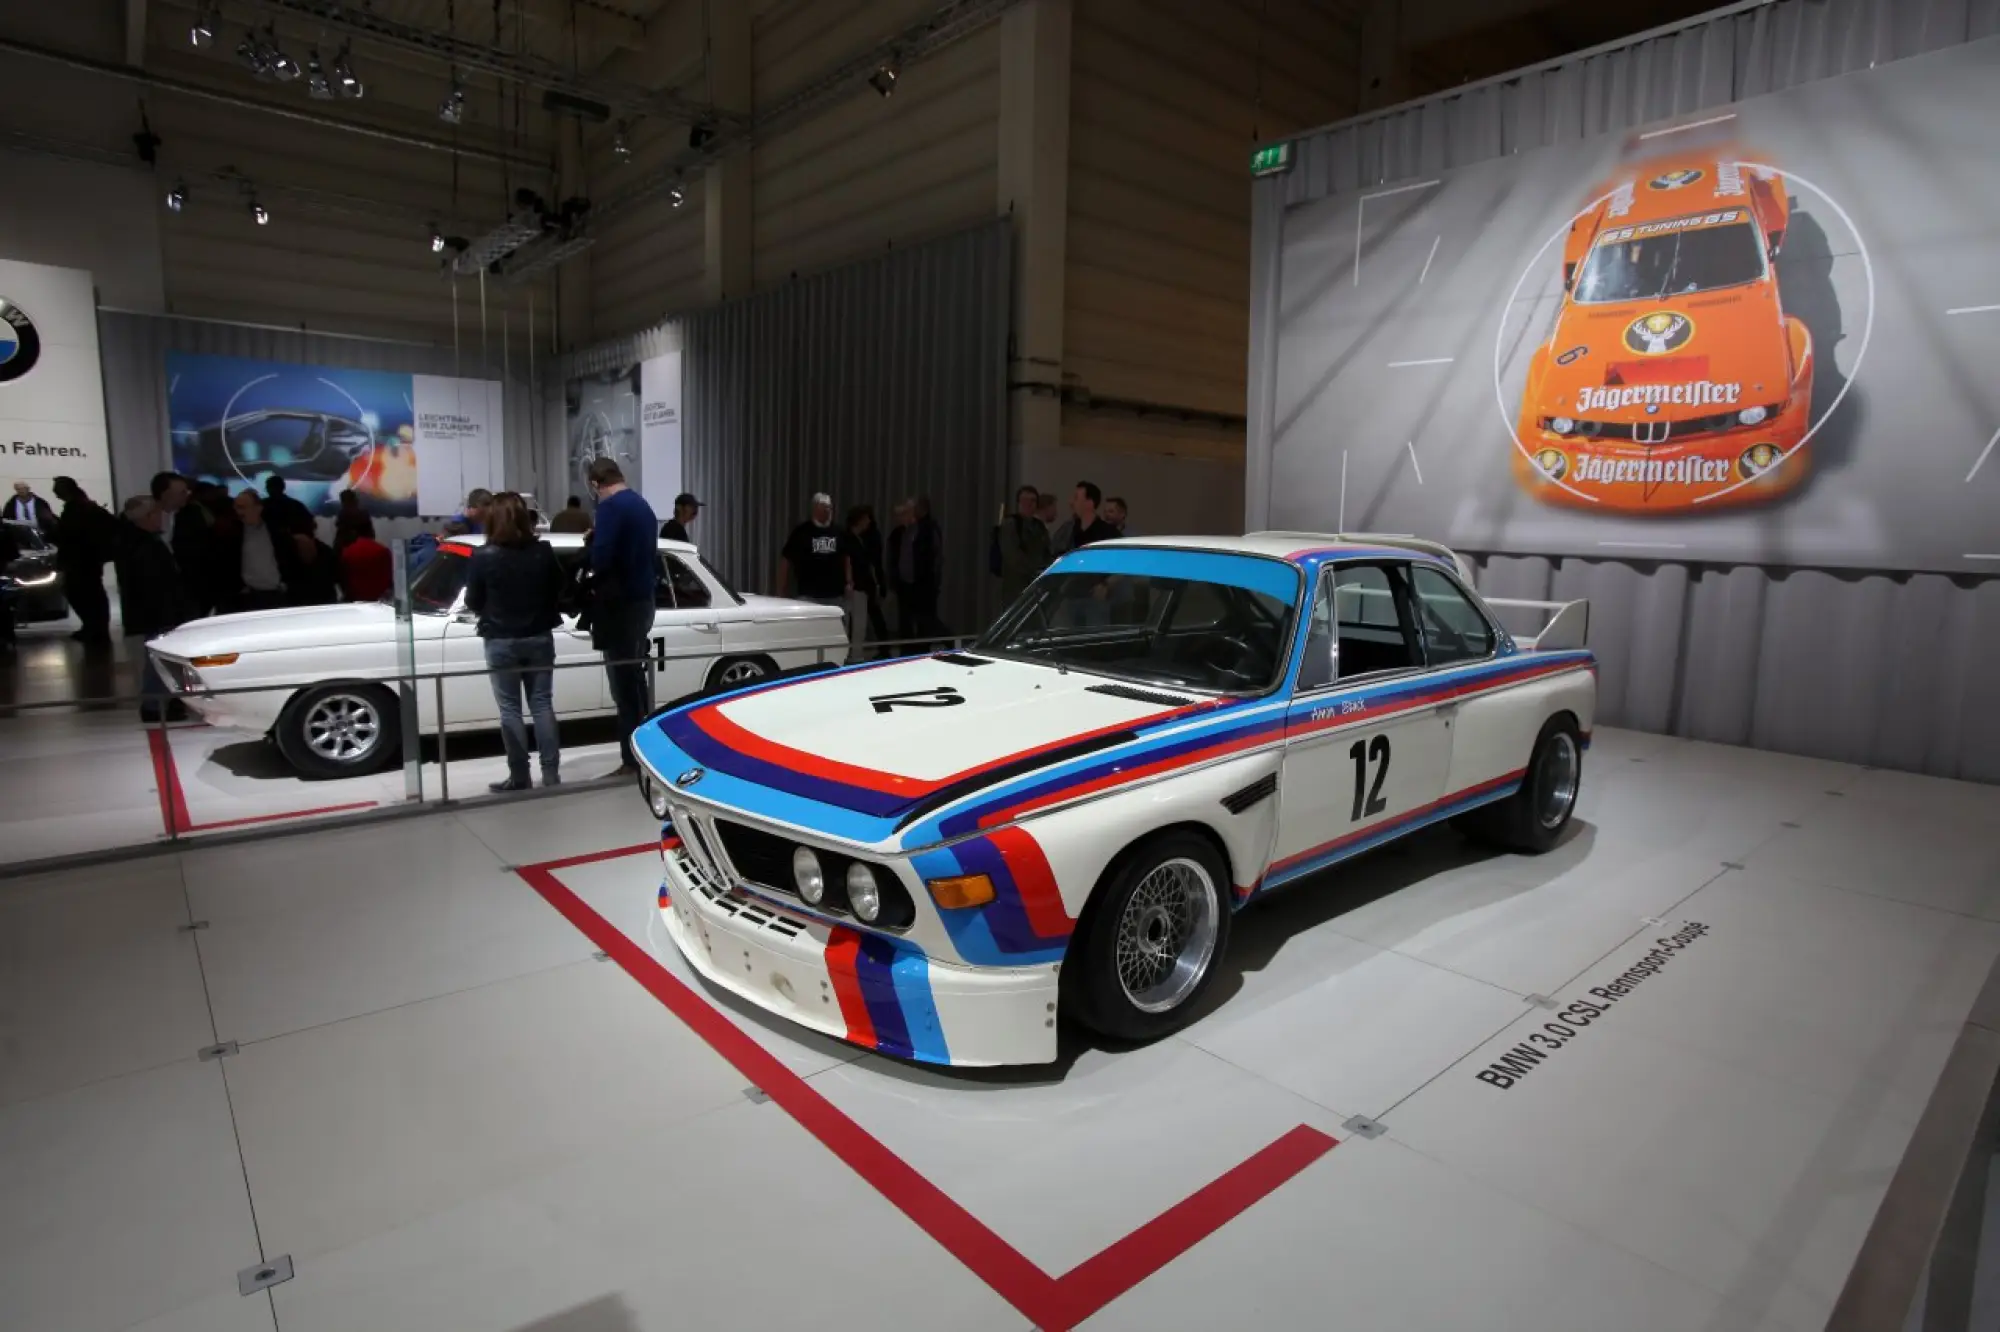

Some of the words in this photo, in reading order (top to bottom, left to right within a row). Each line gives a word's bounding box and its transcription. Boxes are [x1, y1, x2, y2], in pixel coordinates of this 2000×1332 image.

[12, 441, 87, 458] Fahren.
[868, 685, 966, 714] 12
[1349, 733, 1391, 822] 12
[1475, 1042, 1549, 1090] BMW
[1529, 1022, 1577, 1050] 3.0
[1557, 999, 1612, 1028] CSL
